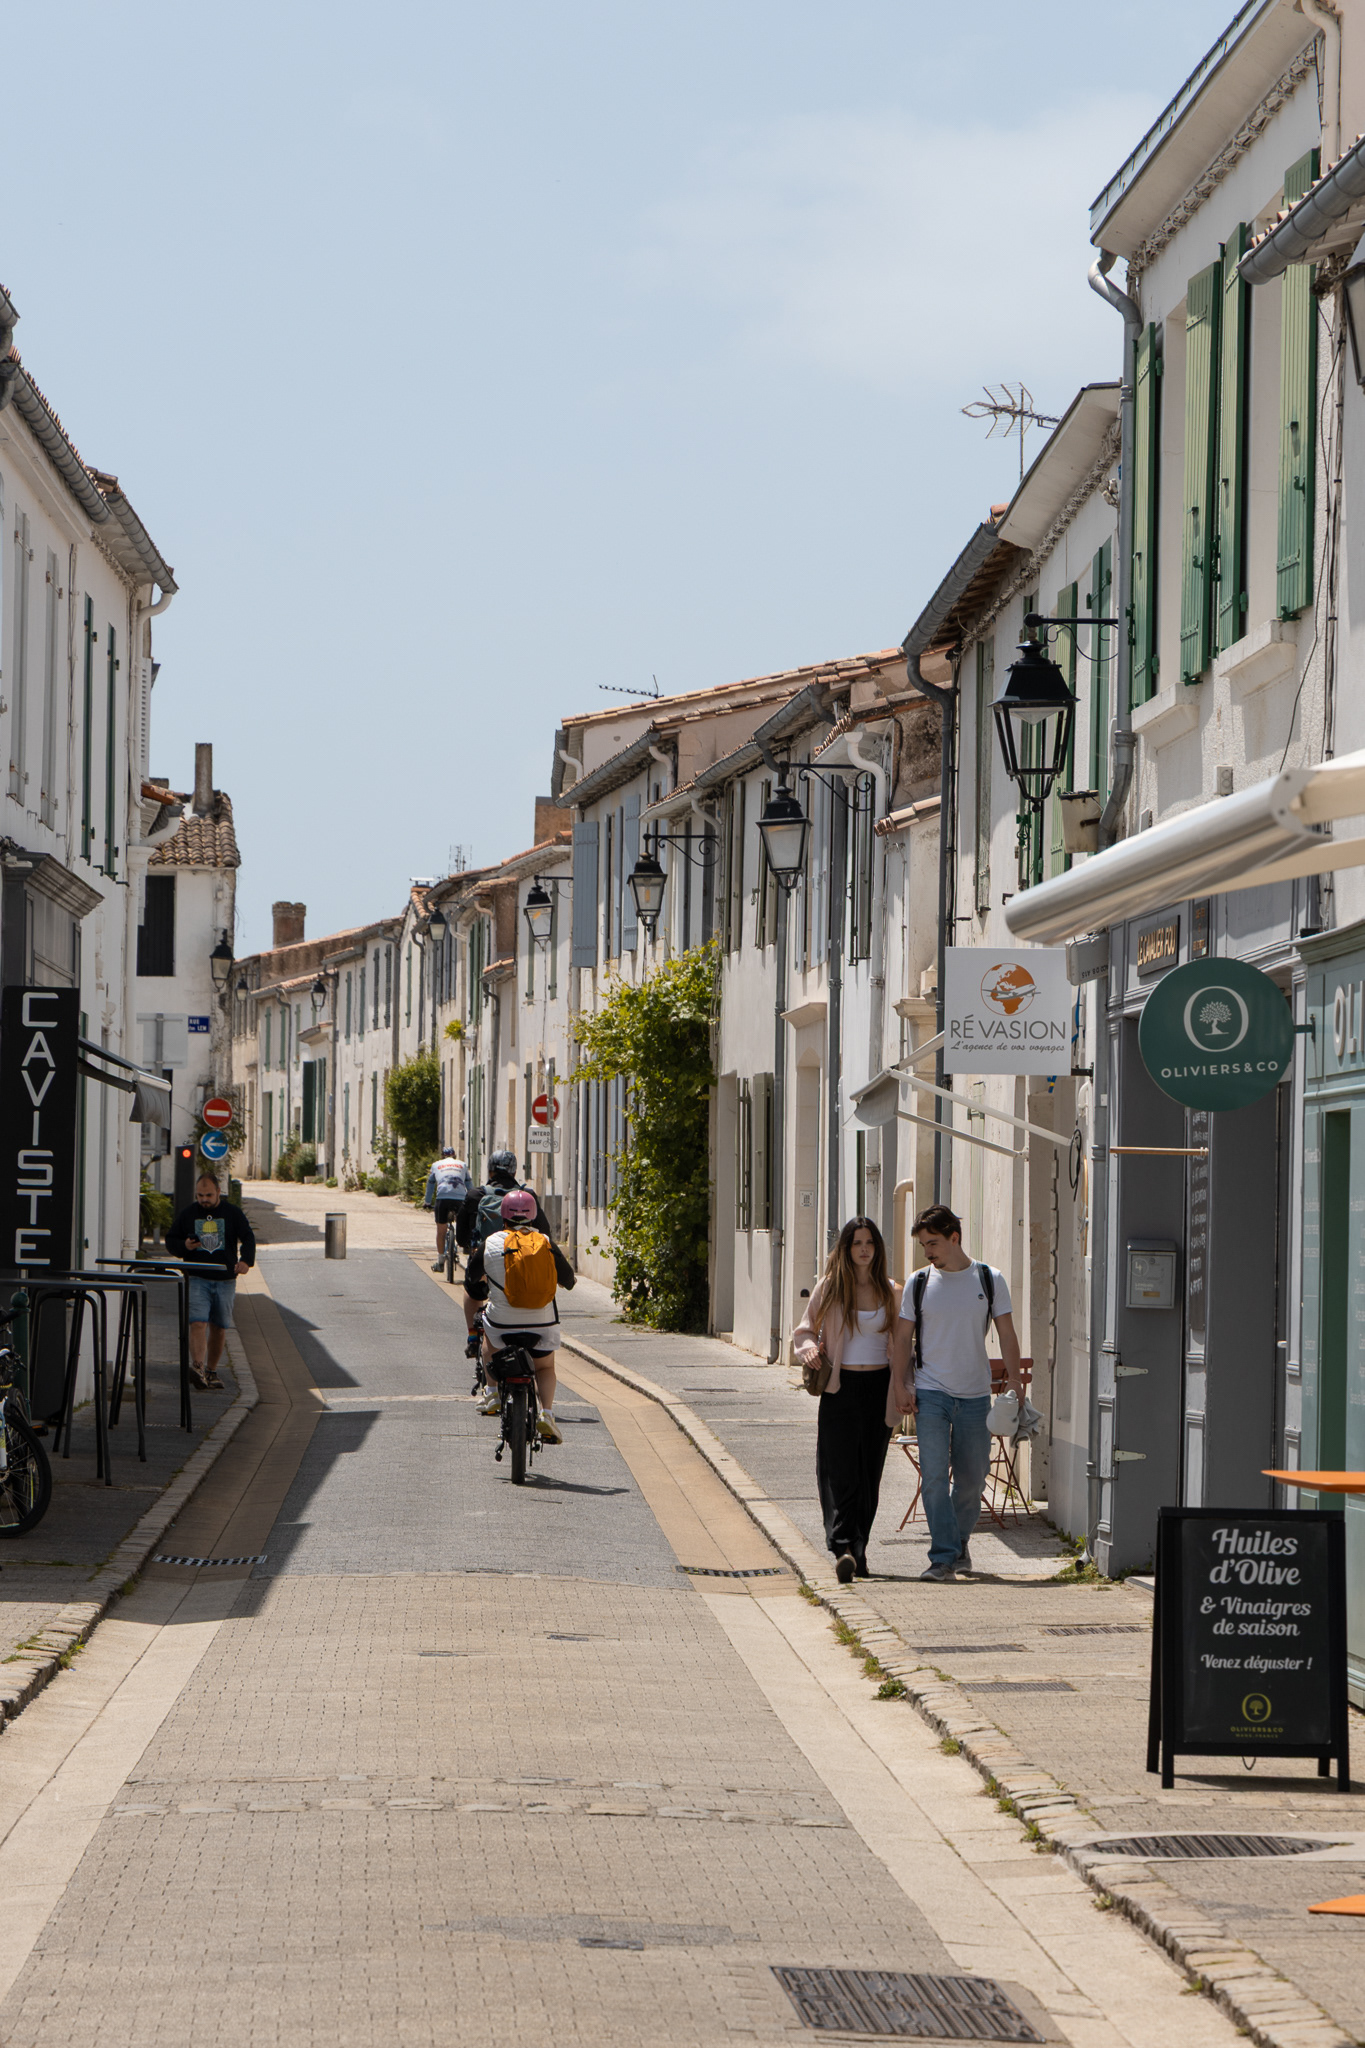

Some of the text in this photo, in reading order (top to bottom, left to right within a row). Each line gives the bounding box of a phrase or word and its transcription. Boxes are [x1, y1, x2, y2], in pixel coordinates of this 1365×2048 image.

[950, 1040, 1065, 1054] L'agence de vos voyages
[14, 991, 60, 1266] CAVISTE
[1211, 1528, 1299, 1556] Huiles
[1209, 1559, 1302, 1586] d'Olive
[1200, 1596, 1312, 1621] & Vinaigres
[1212, 1618, 1301, 1637] de saison
[1200, 1654, 1313, 1674] Venez déguster !
